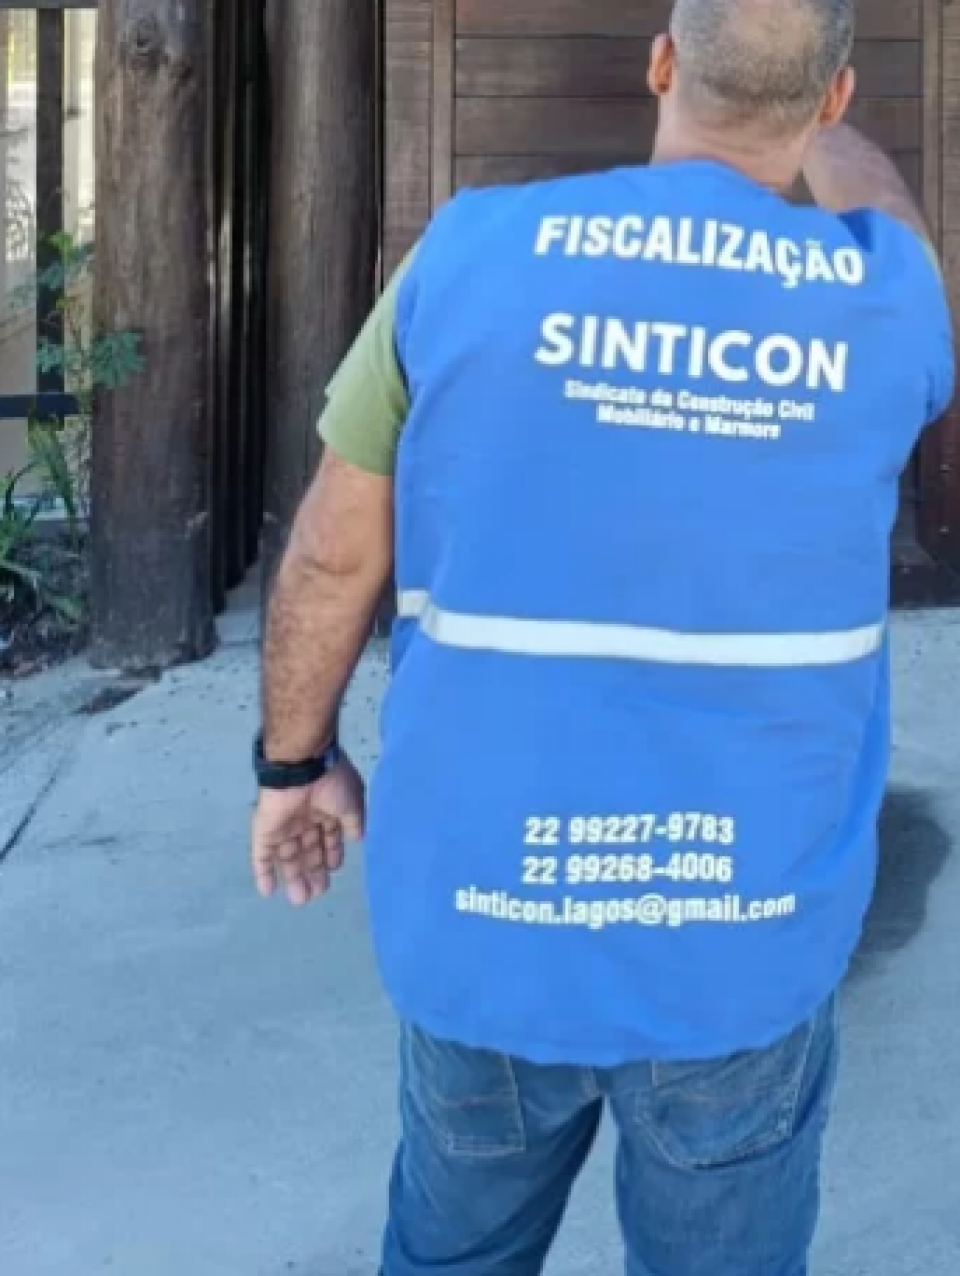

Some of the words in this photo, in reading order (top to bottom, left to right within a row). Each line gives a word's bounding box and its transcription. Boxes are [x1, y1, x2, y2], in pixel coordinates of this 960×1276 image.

[534, 214, 866, 288] FISCALIZAÇÃO
[533, 311, 849, 393] SINTICON
[563, 379, 647, 405] Sindicato
[677, 390, 775, 422] Construção
[778, 399, 816, 422] Civil
[689, 417, 700, 432] e
[523, 816, 561, 845] 22
[567, 811, 735, 845] 99227-9783
[521, 855, 558, 885] 22
[565, 851, 734, 885] 99268-4006
[454, 884, 797, 930] sinticon.lagos@gmail.com
